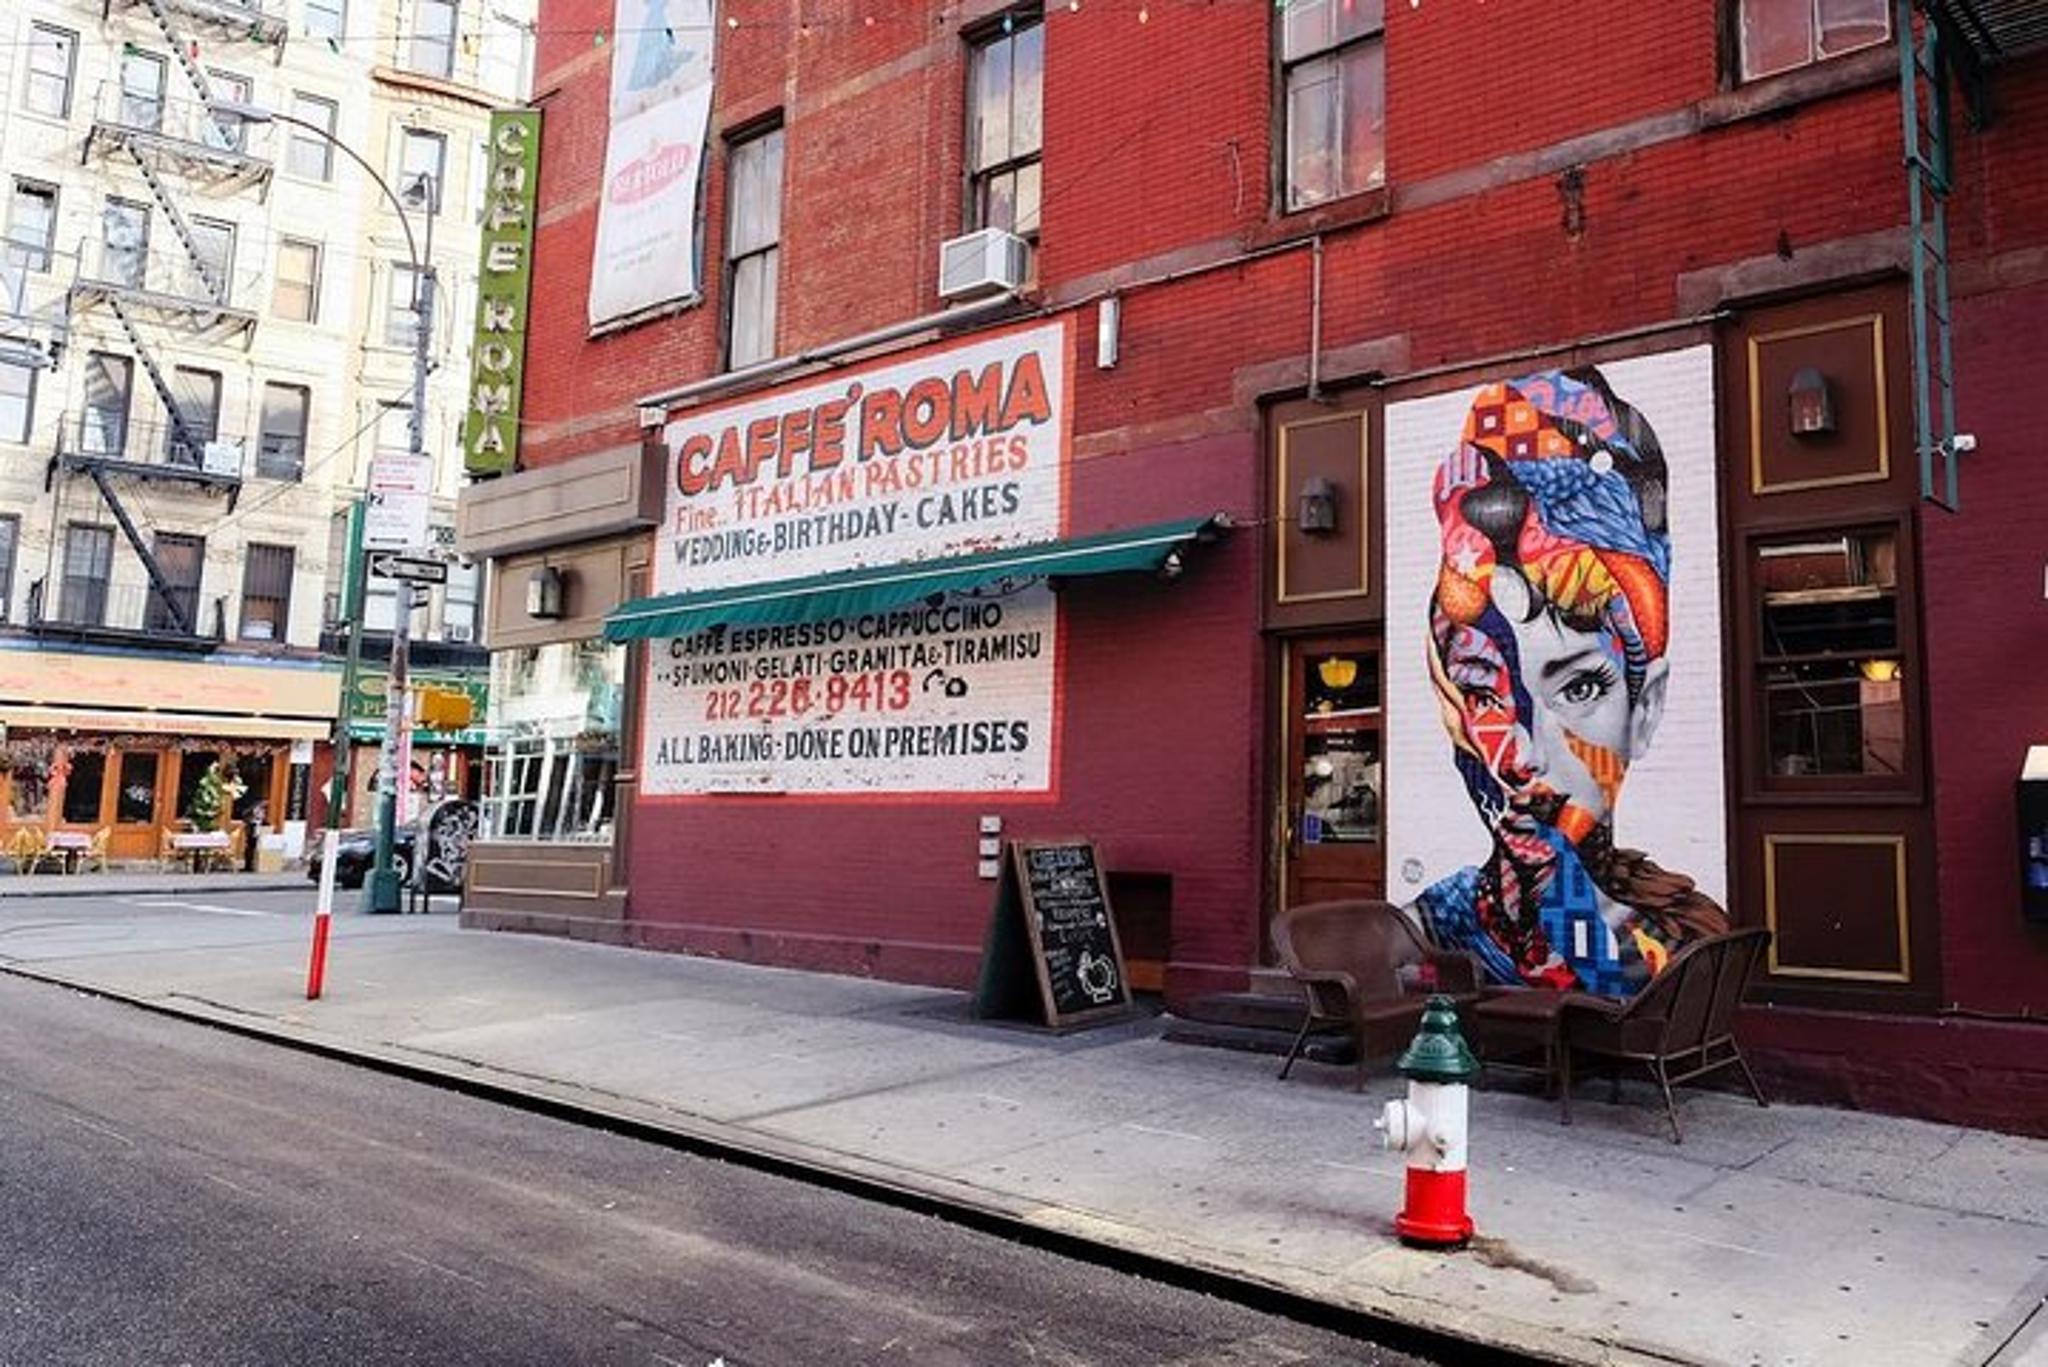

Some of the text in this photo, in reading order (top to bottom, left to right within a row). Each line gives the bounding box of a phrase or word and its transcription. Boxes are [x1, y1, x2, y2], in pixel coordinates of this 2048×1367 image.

[474, 301, 514, 454] ROMA
[857, 351, 1051, 461] ROMA
[735, 467, 856, 520] ITALIAN
[865, 435, 1029, 496] PASTRIES
[917, 483, 1020, 529] CAKES
[731, 619, 845, 653] ESPRESSO
[858, 603, 1002, 639] CAPPUCCINO
[944, 632, 1041, 666] TIRAMISU
[706, 689, 740, 720] 212
[658, 737, 693, 764] ALL
[785, 728, 843, 760] DONE
[848, 728, 879, 758] ON
[884, 721, 1029, 757] PREMISES
